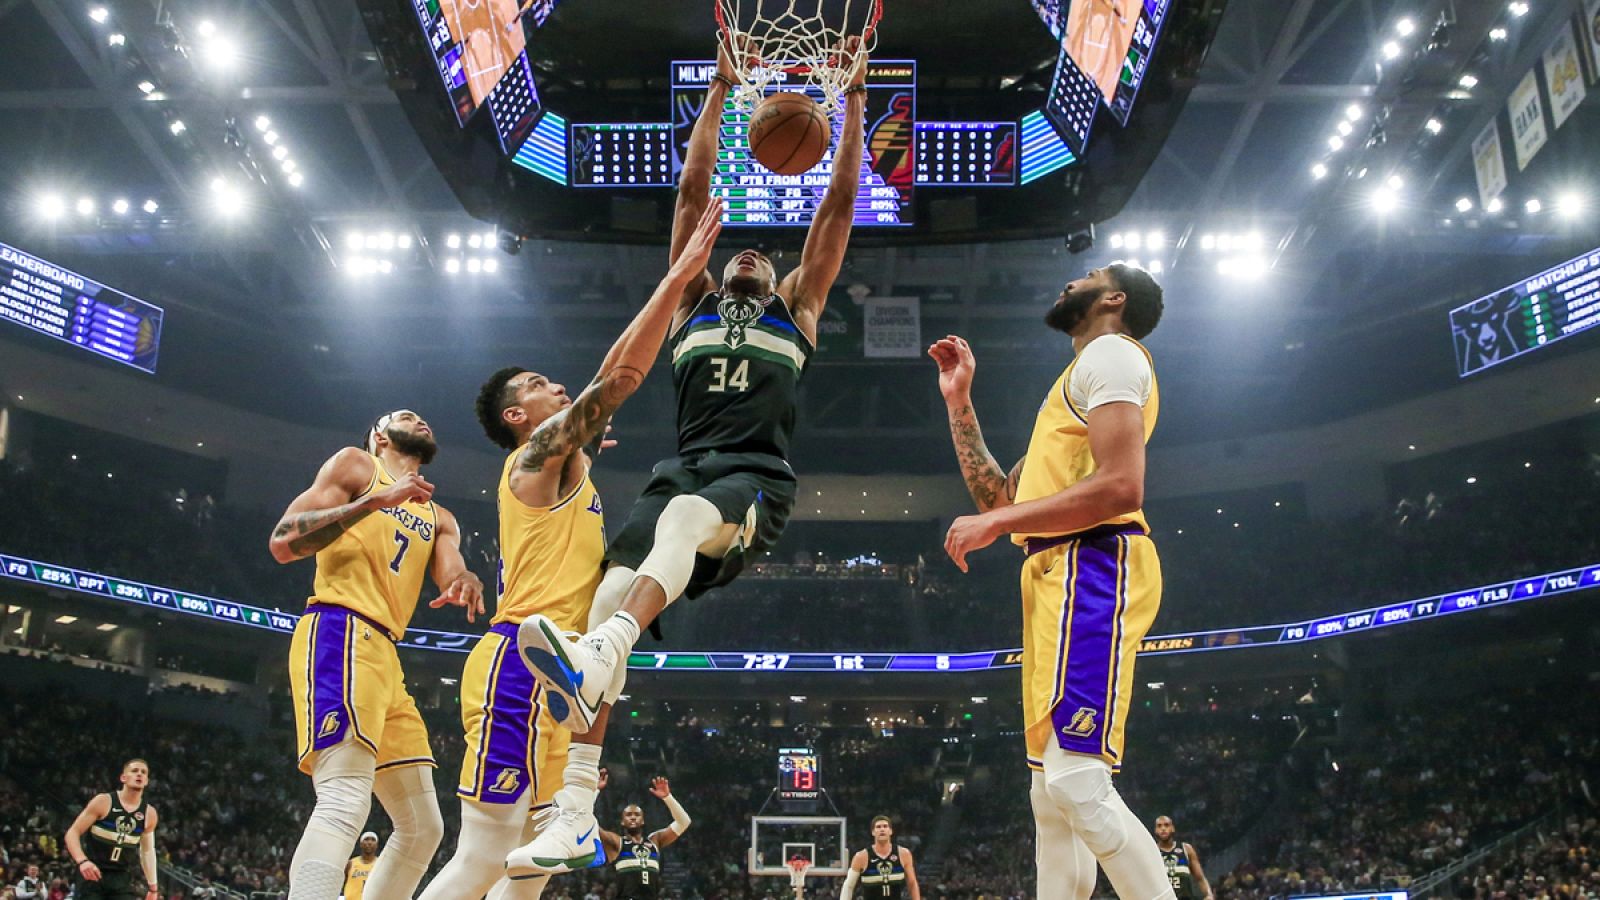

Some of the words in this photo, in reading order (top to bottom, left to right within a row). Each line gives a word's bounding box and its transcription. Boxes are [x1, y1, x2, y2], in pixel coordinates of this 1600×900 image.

[645, 132, 650, 141] 1
[660, 132, 667, 141] 0
[614, 143, 619, 152] 1
[629, 143, 634, 152] 1
[644, 143, 651, 152] 0
[661, 143, 666, 152] 1
[937, 142, 944, 150] 0
[970, 142, 975, 150] 1
[984, 142, 992, 150] 0
[613, 154, 620, 162] 0
[628, 154, 635, 162] 0
[644, 154, 651, 162] 0
[660, 154, 667, 162] 0
[920, 152, 926, 161] 7
[936, 152, 944, 161] 0
[952, 152, 960, 161] 0
[969, 152, 976, 161] 0
[984, 152, 992, 161] 0
[613, 164, 620, 173] 0
[629, 164, 634, 173] 1
[644, 164, 651, 173] 0
[660, 164, 667, 173] 0
[952, 163, 959, 171] 0
[968, 163, 976, 171] 0
[984, 163, 991, 171] 0
[628, 175, 635, 183] 0
[645, 175, 651, 183] 1
[661, 175, 666, 183] 1
[739, 175, 764, 185] PTS
[765, 175, 800, 185] FROM
[804, 175, 831, 185] DUN
[936, 174, 943, 182] 0
[970, 174, 975, 182] 1
[985, 174, 990, 182] 1
[781, 200, 806, 210] 3PT
[786, 213, 801, 222] FT
[877, 213, 894, 222] 0%
[1526, 258, 1589, 293] MATCHUP
[30, 275, 63, 295] LEADER
[29, 286, 61, 304] LEADER
[37, 299, 69, 318] LEADER
[33, 308, 66, 327] LEADER
[31, 318, 64, 336] LEADER
[1537, 334, 1547, 345] 0
[708, 357, 749, 392] 34
[389, 528, 409, 574] 7
[8, 562, 28, 575] FG
[41, 568, 71, 585] 25%
[79, 576, 105, 592] 3PT
[116, 583, 144, 600] 33%
[152, 591, 170, 605] FT
[182, 597, 208, 612] 50%
[215, 603, 238, 618] FLS
[250, 611, 261, 623] 2
[271, 615, 294, 630] TOL
[1287, 628, 1304, 640] FG
[1317, 621, 1342, 635] 20%
[1347, 613, 1372, 628] 3PT
[1383, 607, 1409, 622] 20%
[1417, 602, 1434, 616] FT
[1457, 595, 1477, 609] 0%
[1483, 588, 1509, 603] FLS
[1525, 583, 1534, 594] 1
[1548, 575, 1577, 590] TOL
[1136, 638, 1194, 652] AKERS
[653, 654, 668, 669] 7
[743, 654, 790, 669] 7:27
[832, 655, 864, 670] 1st
[936, 655, 950, 670] 5
[793, 771, 813, 789] 13
[111, 847, 121, 862] 0
[642, 871, 649, 885] 9
[882, 885, 890, 897] 11
